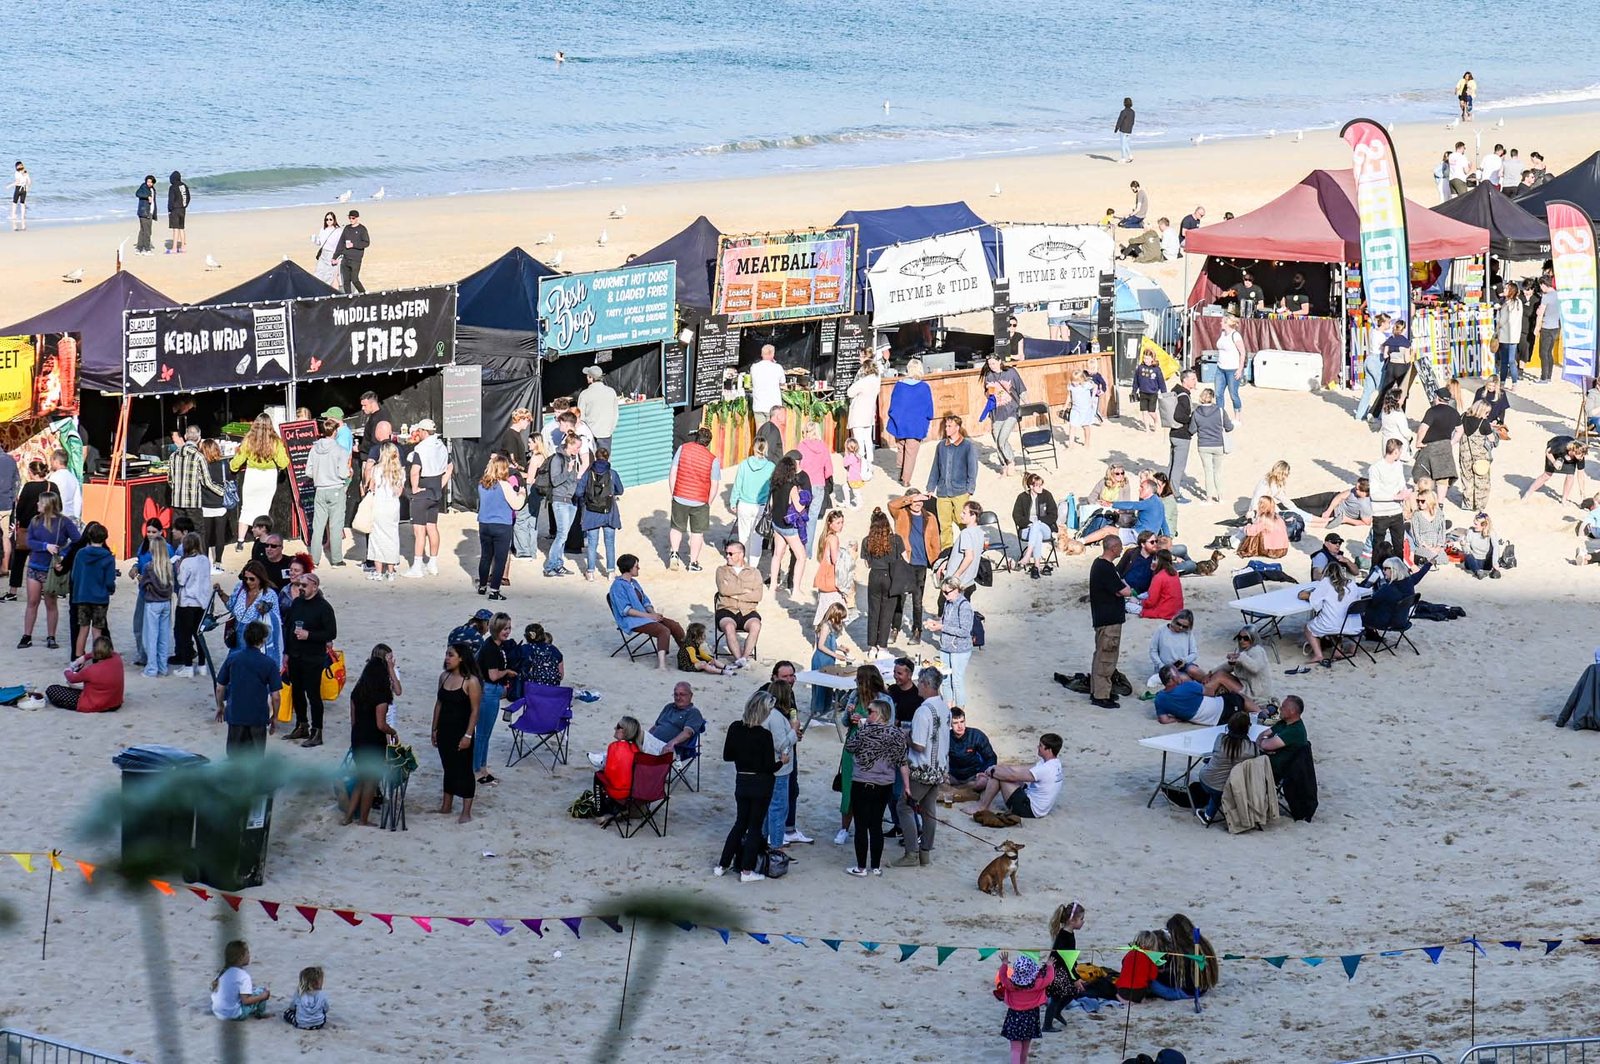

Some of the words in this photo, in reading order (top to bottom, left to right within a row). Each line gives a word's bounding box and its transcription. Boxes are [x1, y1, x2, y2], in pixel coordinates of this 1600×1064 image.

[736, 252, 818, 275] MEATBALL
[592, 275, 630, 290] GOURMET
[631, 272, 645, 284] HOT
[648, 270, 668, 283] DOGS
[817, 280, 838, 288] Loaded
[1018, 268, 1056, 284] THYME
[1060, 268, 1067, 280] &
[1072, 266, 1096, 279] TIDE
[607, 293, 614, 303] &
[616, 287, 646, 302] LOADED
[647, 284, 668, 298] FRIES
[728, 288, 750, 298] Loaded
[761, 291, 777, 300] Pasta
[890, 284, 932, 303] THYME
[937, 282, 946, 295] &
[950, 276, 978, 293] TIDE
[546, 279, 588, 324] Posh
[728, 299, 750, 308] Nachos
[333, 306, 377, 326] MIDDLE
[380, 299, 430, 322] EASTERN
[130, 320, 145, 332] SLAP
[146, 319, 155, 330] UP
[557, 305, 596, 350] Dogs
[130, 337, 142, 346] GOOD
[143, 336, 155, 344] FOOD
[164, 330, 210, 355] KEBAB
[212, 327, 248, 352] WRAP
[350, 327, 418, 366] FRIES
[136, 350, 148, 358] JUST
[130, 362, 146, 373] TASTE
